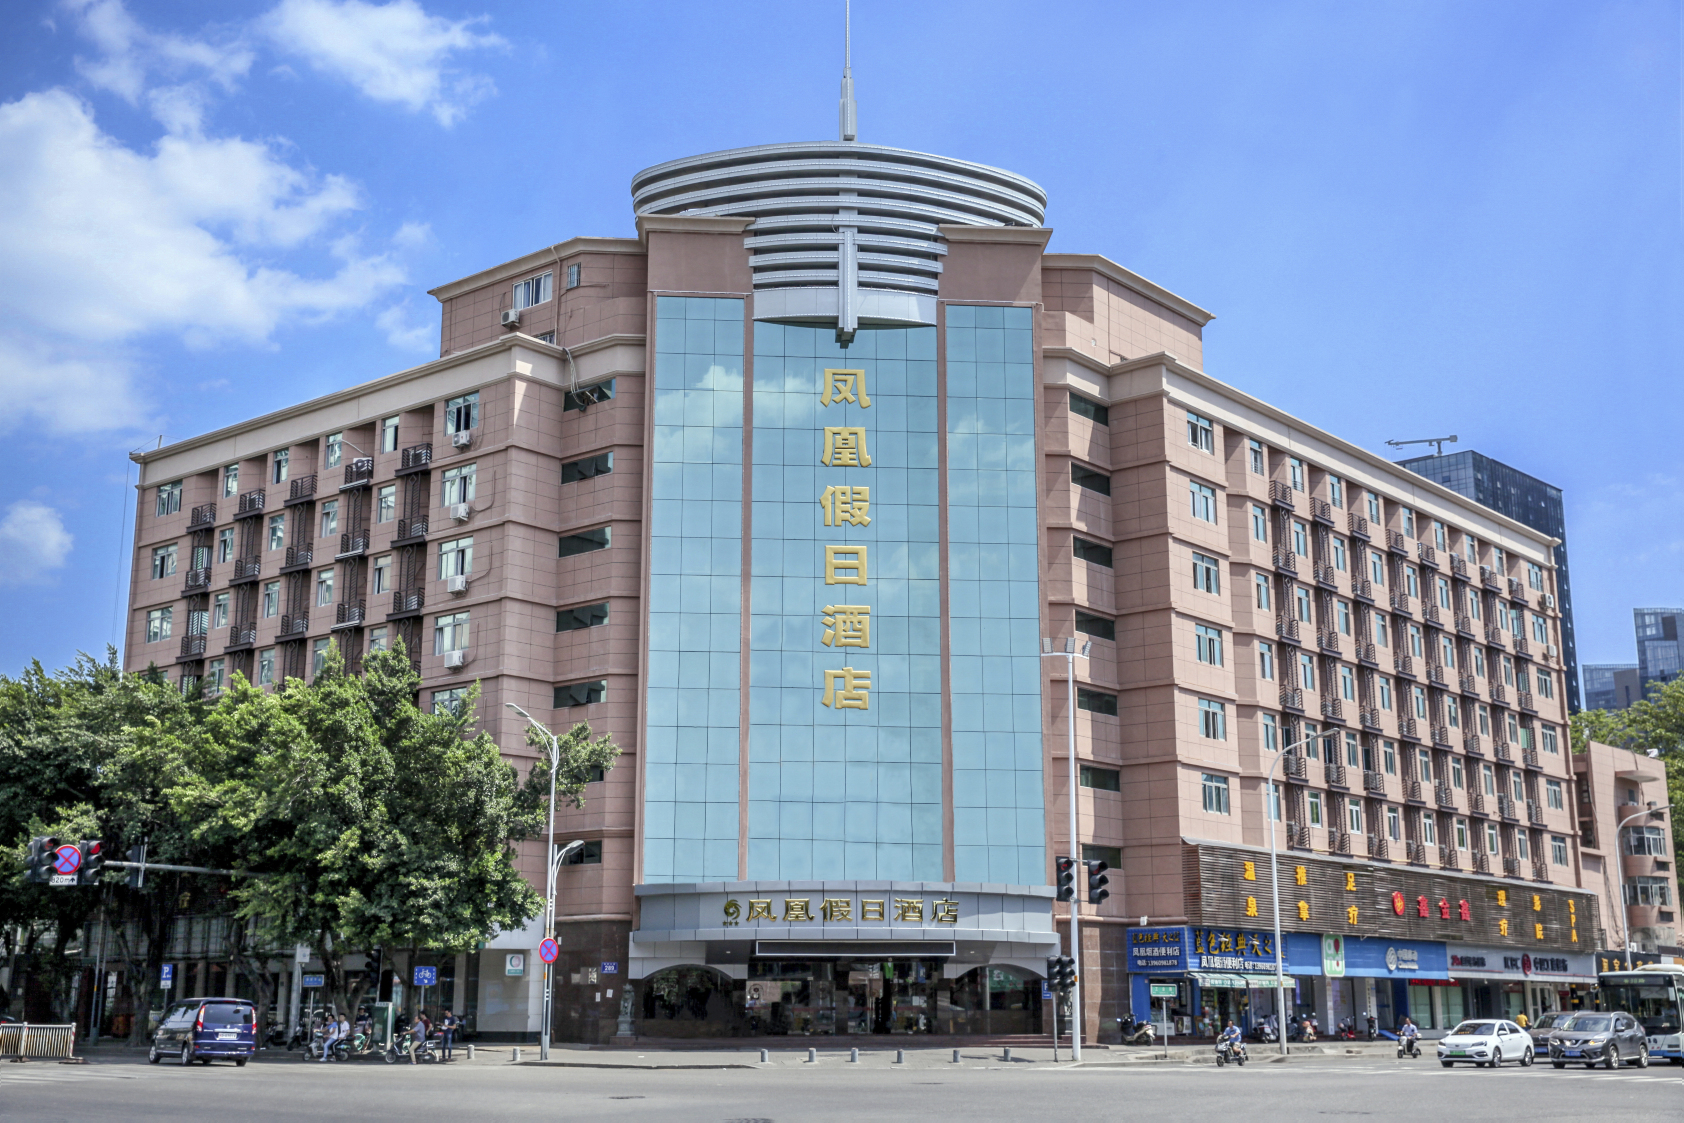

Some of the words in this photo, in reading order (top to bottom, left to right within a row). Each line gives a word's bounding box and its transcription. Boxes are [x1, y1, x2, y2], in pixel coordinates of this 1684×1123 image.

[819, 368, 871, 711] 凤凰假日酒店
[746, 897, 959, 924] 凤凰假日酒店
[1243, 861, 1258, 917] 温泉
[1295, 865, 1310, 921] 推拿
[1345, 873, 1359, 925] 足疗
[1568, 899, 1578, 943] SPA
[1132, 946, 1180, 957] 凤凰烟酒便利店
